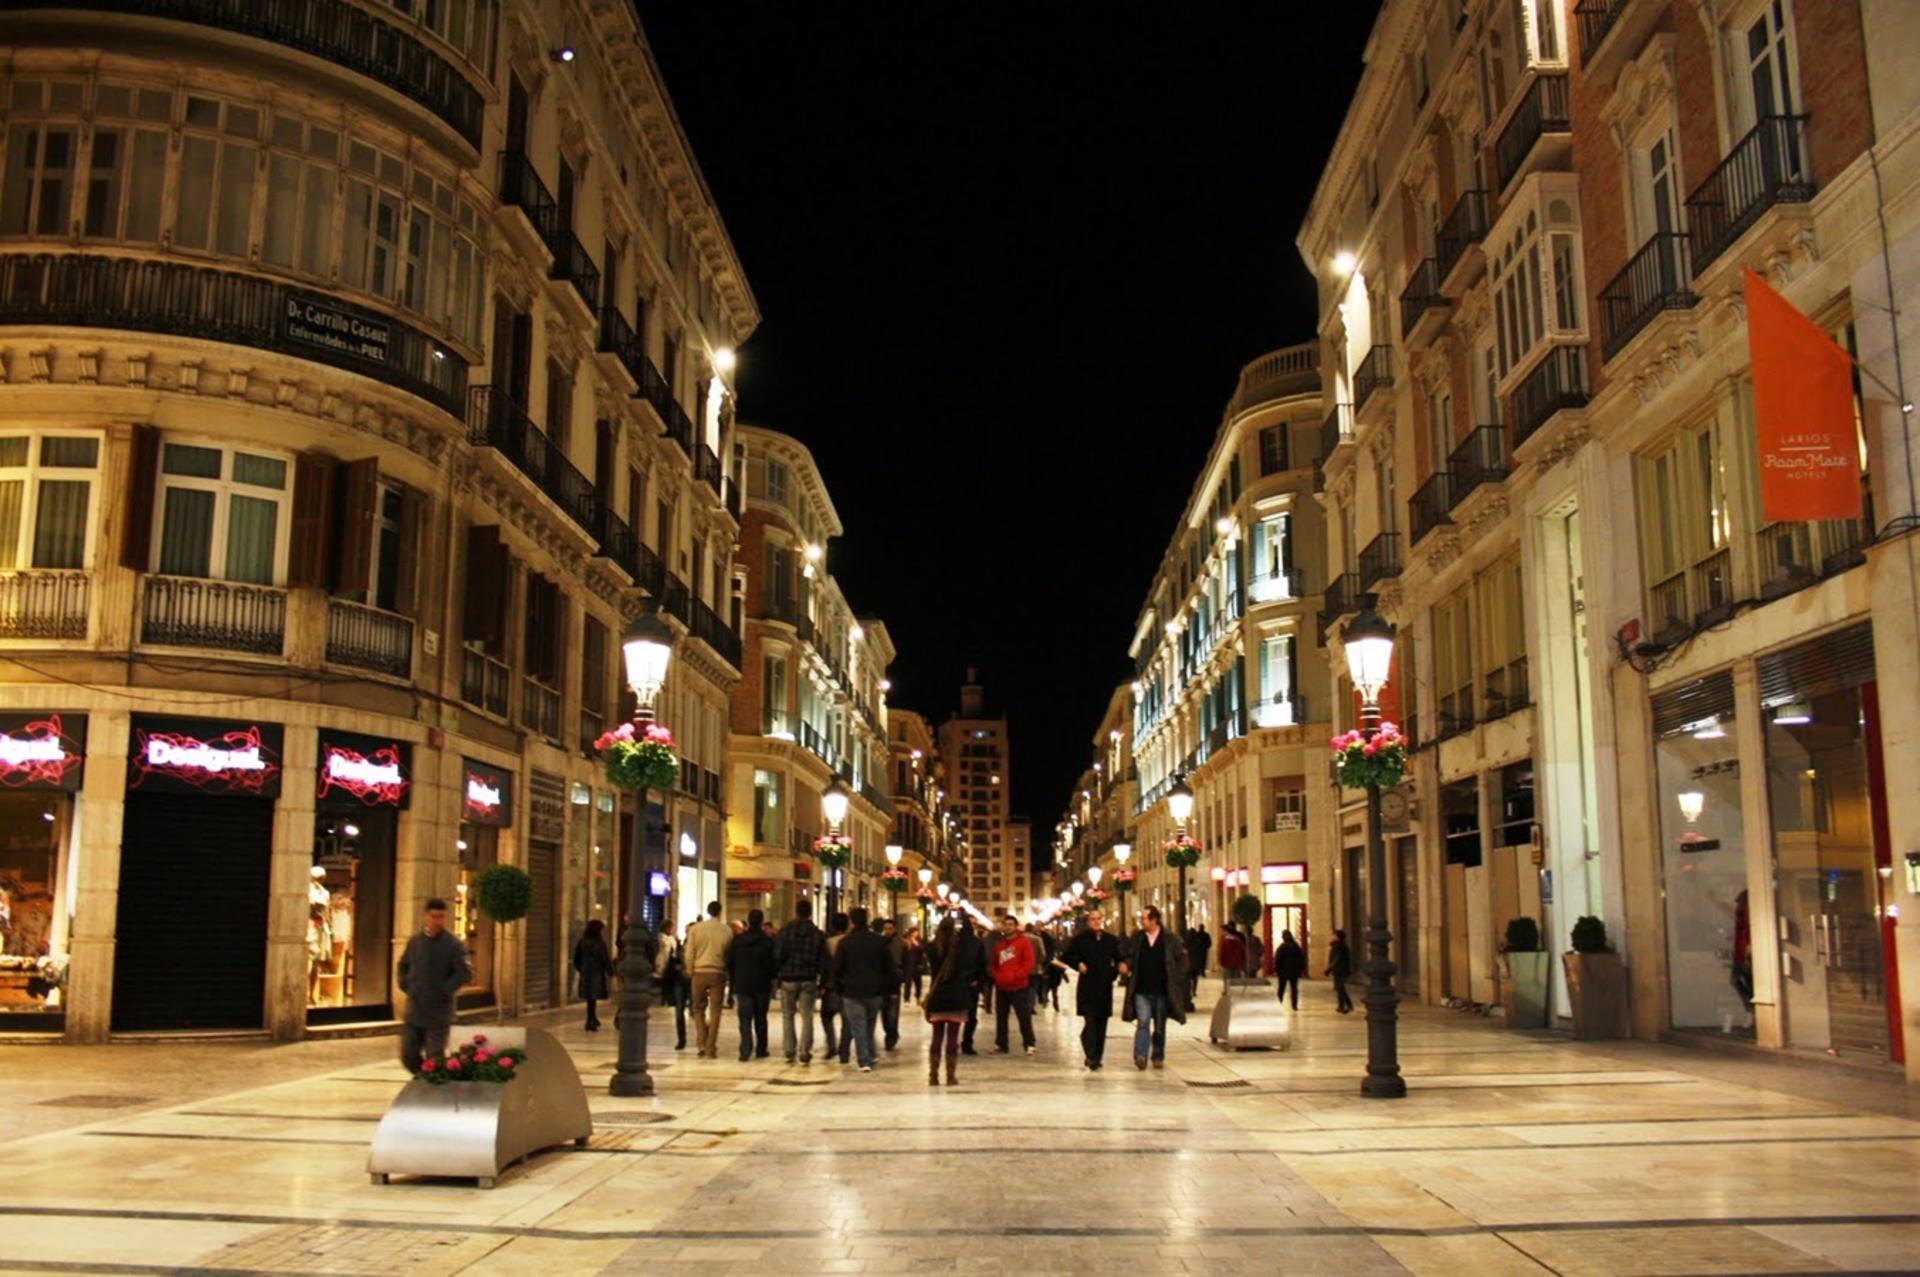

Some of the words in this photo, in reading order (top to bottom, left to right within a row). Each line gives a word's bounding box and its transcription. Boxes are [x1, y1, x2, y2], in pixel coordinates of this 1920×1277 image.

[287, 300, 303, 320] Dr.
[305, 306, 349, 332] Carrillo
[361, 343, 385, 360] PIEL
[1780, 434, 1831, 444] LARIOS
